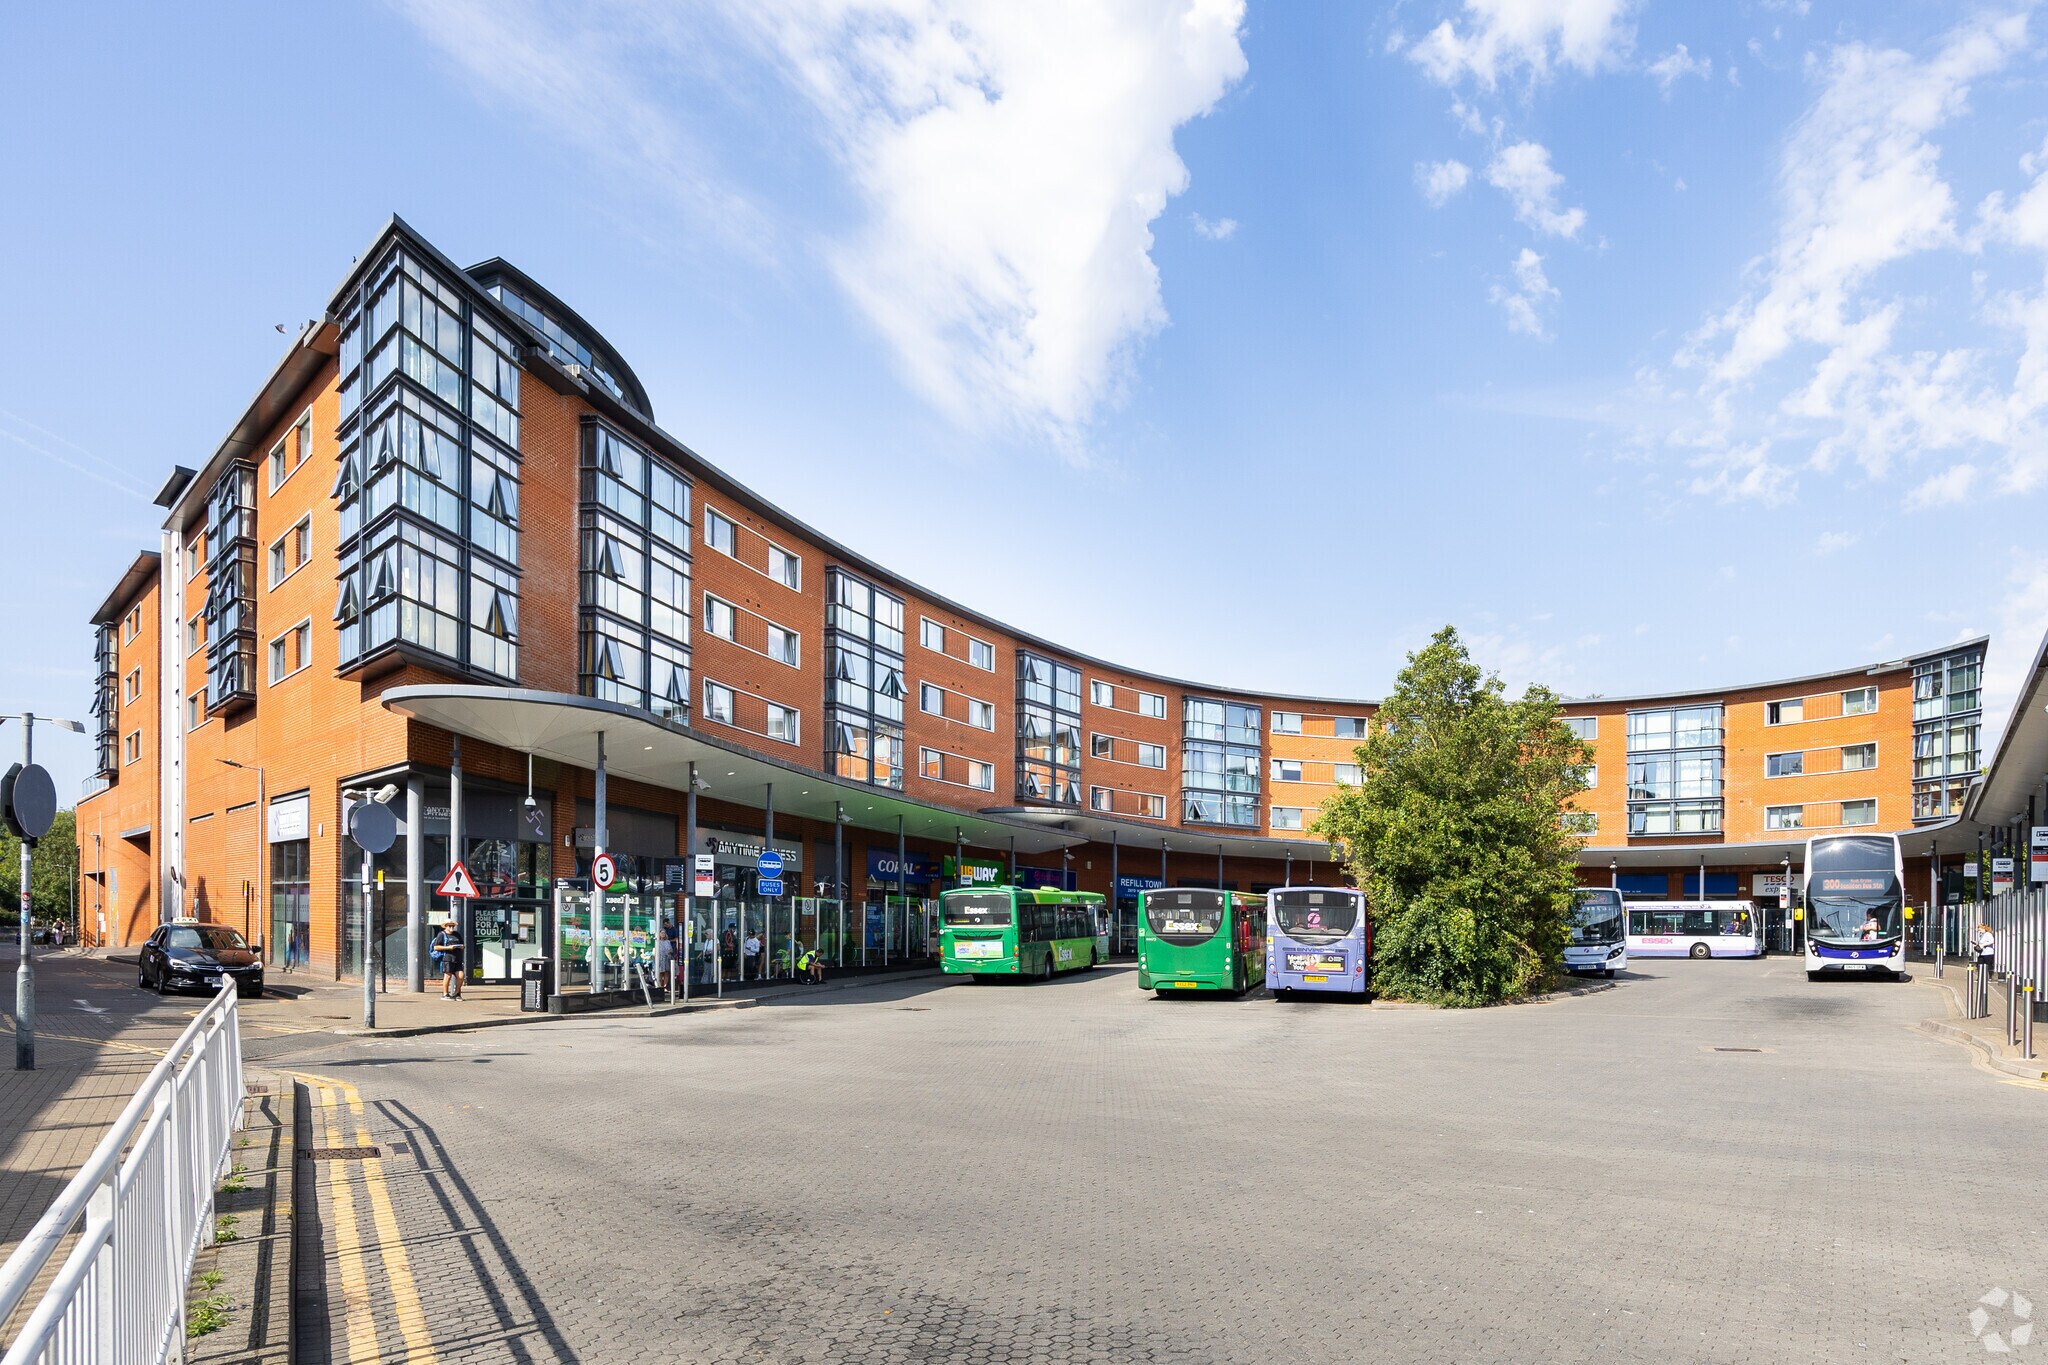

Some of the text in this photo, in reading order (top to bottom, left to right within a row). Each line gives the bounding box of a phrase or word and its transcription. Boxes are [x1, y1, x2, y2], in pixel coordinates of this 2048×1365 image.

[718, 840, 760, 857] ANYTIME
[599, 863, 609, 882] 5
[1120, 878, 1144, 888] REFILL
[1823, 879, 1840, 889] 300
[964, 906, 988, 914] Essex
[1166, 920, 1199, 931] Essex
